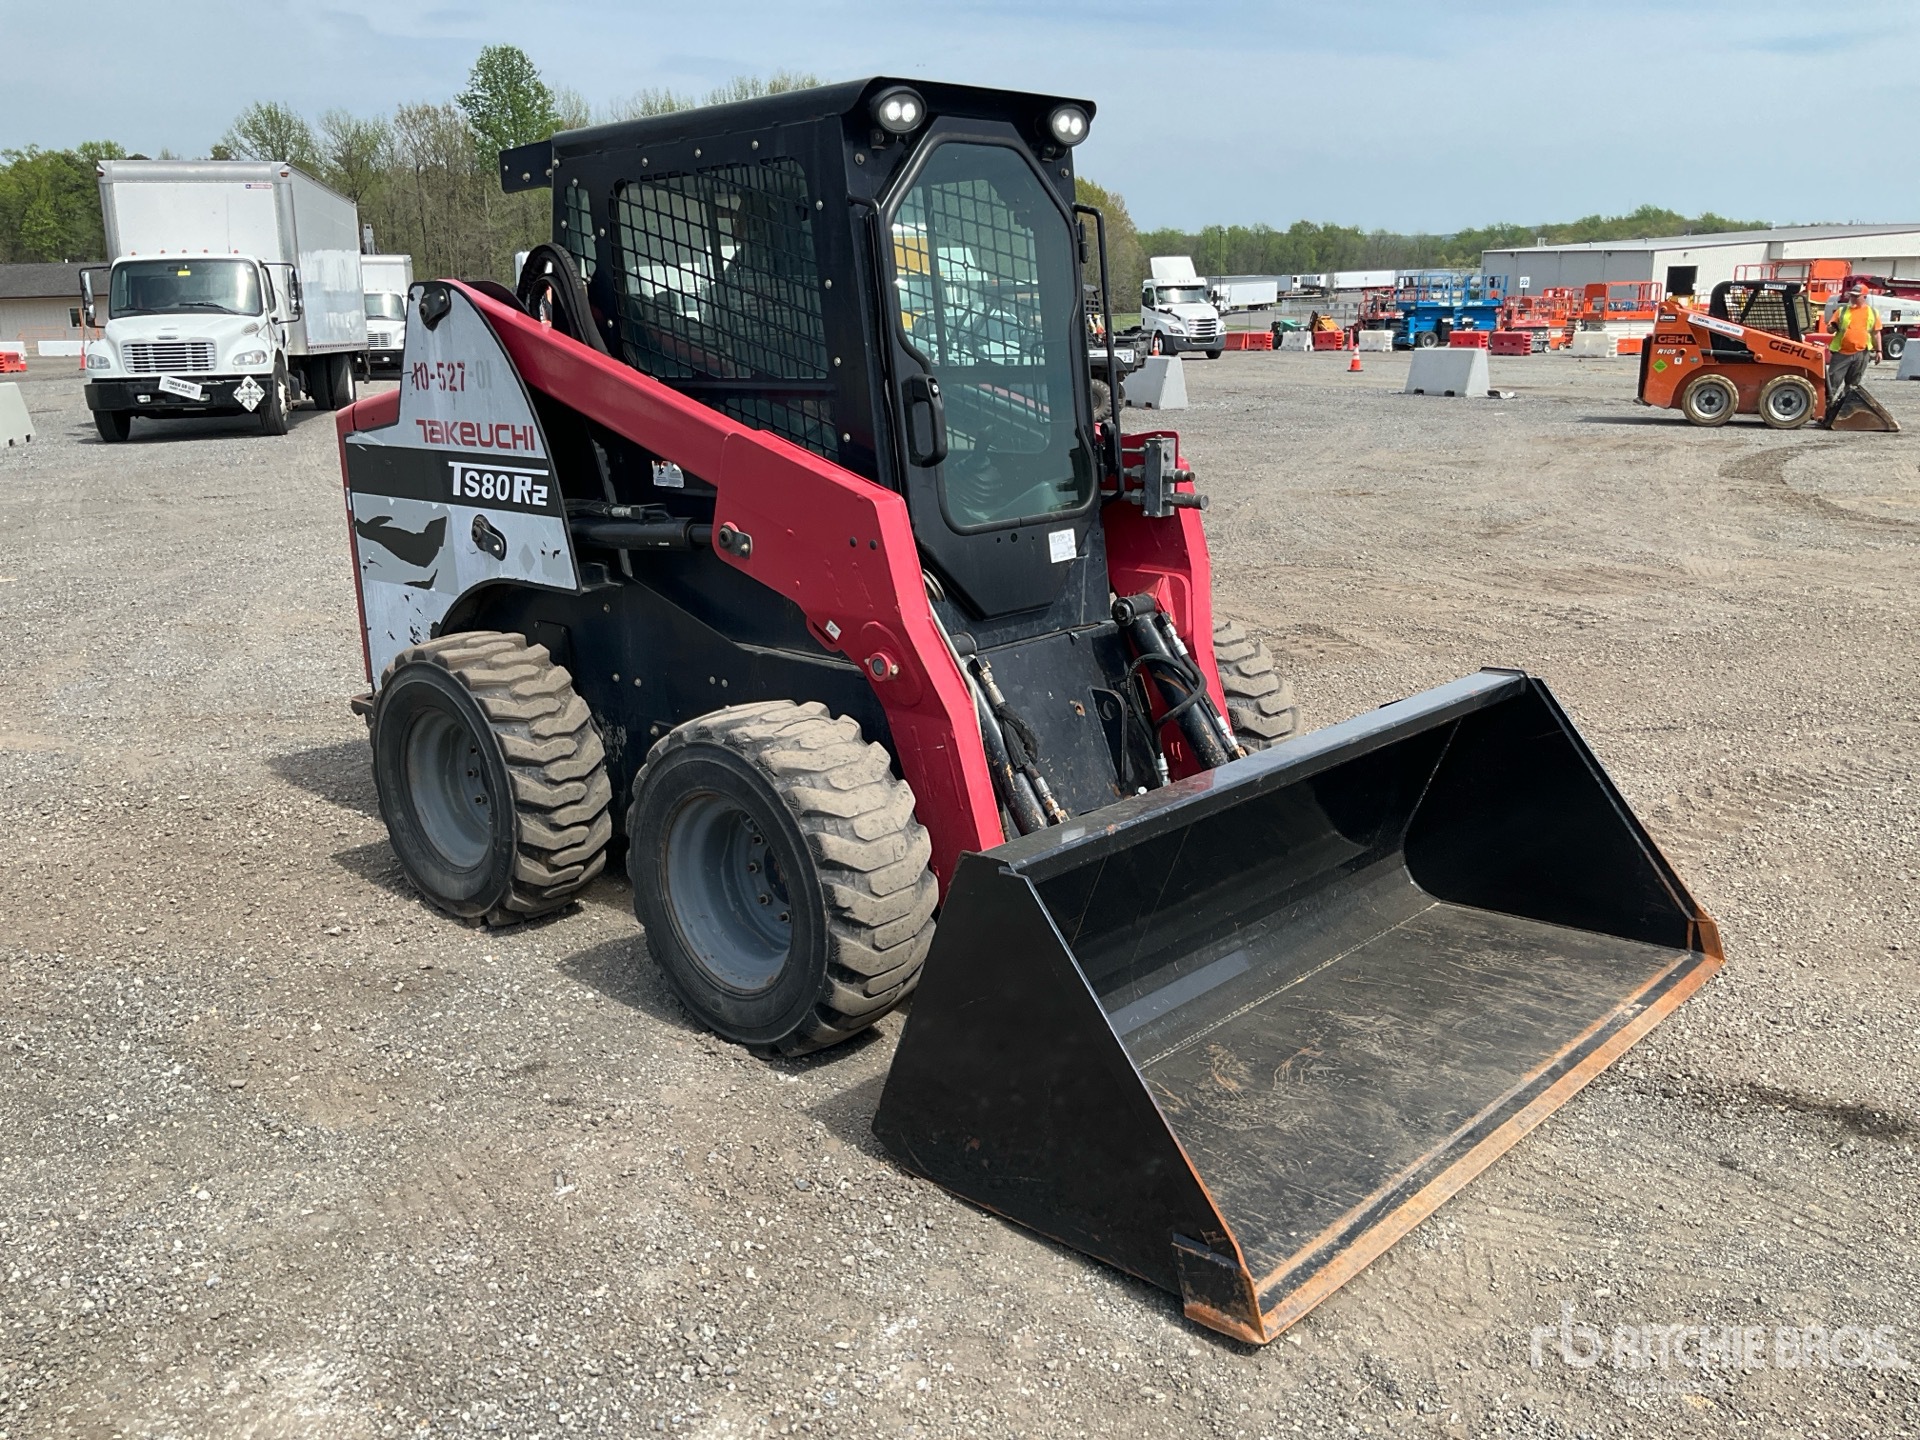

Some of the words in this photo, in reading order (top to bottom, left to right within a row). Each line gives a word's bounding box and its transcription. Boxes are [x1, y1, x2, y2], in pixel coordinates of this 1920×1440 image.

[1657, 335, 1693, 344] GEHL
[1769, 340, 1811, 360] GEHL
[416, 419, 535, 451] TAKEUCHI
